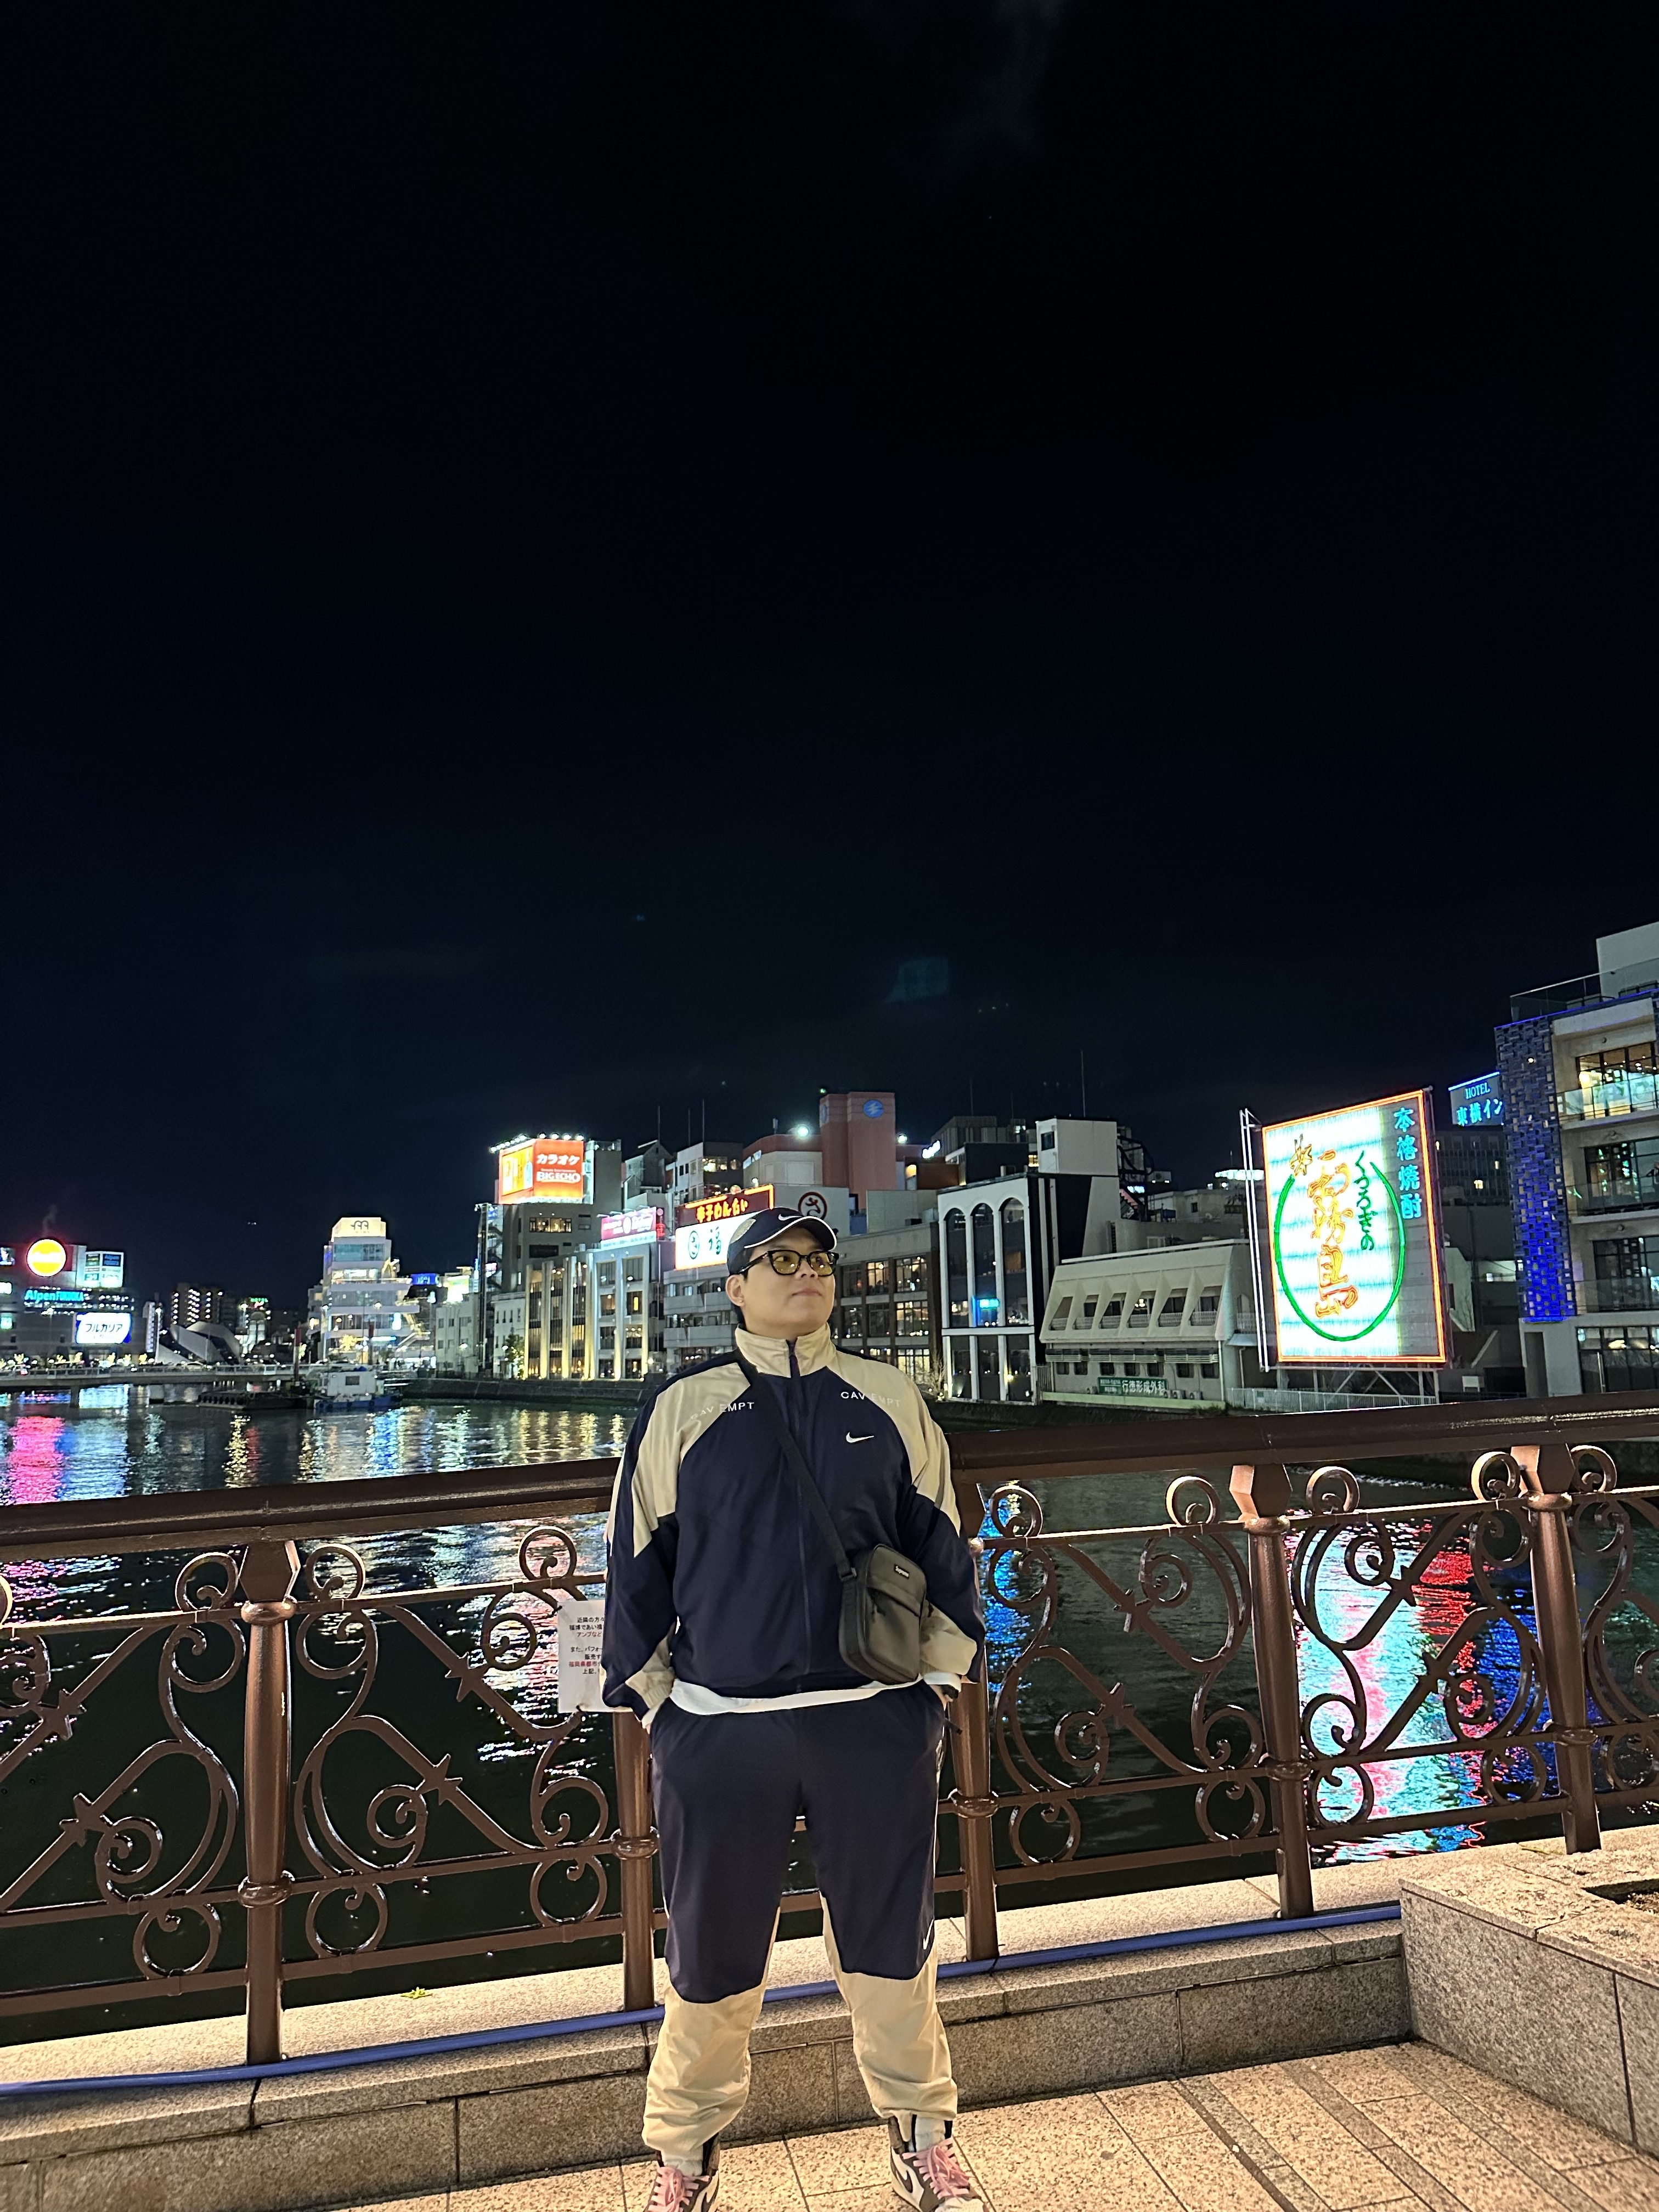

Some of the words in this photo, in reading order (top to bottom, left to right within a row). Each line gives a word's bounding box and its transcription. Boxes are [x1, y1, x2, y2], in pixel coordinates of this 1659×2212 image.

[1464, 1082, 1491, 1099] HOTEL
[1456, 1098, 1503, 1127] 東横イン
[536, 1154, 580, 1166] カラオケ
[1393, 1107, 1423, 1220] 本格焼酎
[535, 1171, 555, 1182] BIG
[555, 1172, 582, 1183] ECHO
[1354, 1150, 1377, 1251] くつろぎの
[720, 1402, 755, 1412] EMPT
[840, 1391, 865, 1400] CAV
[871, 1393, 901, 1408] EMPT
